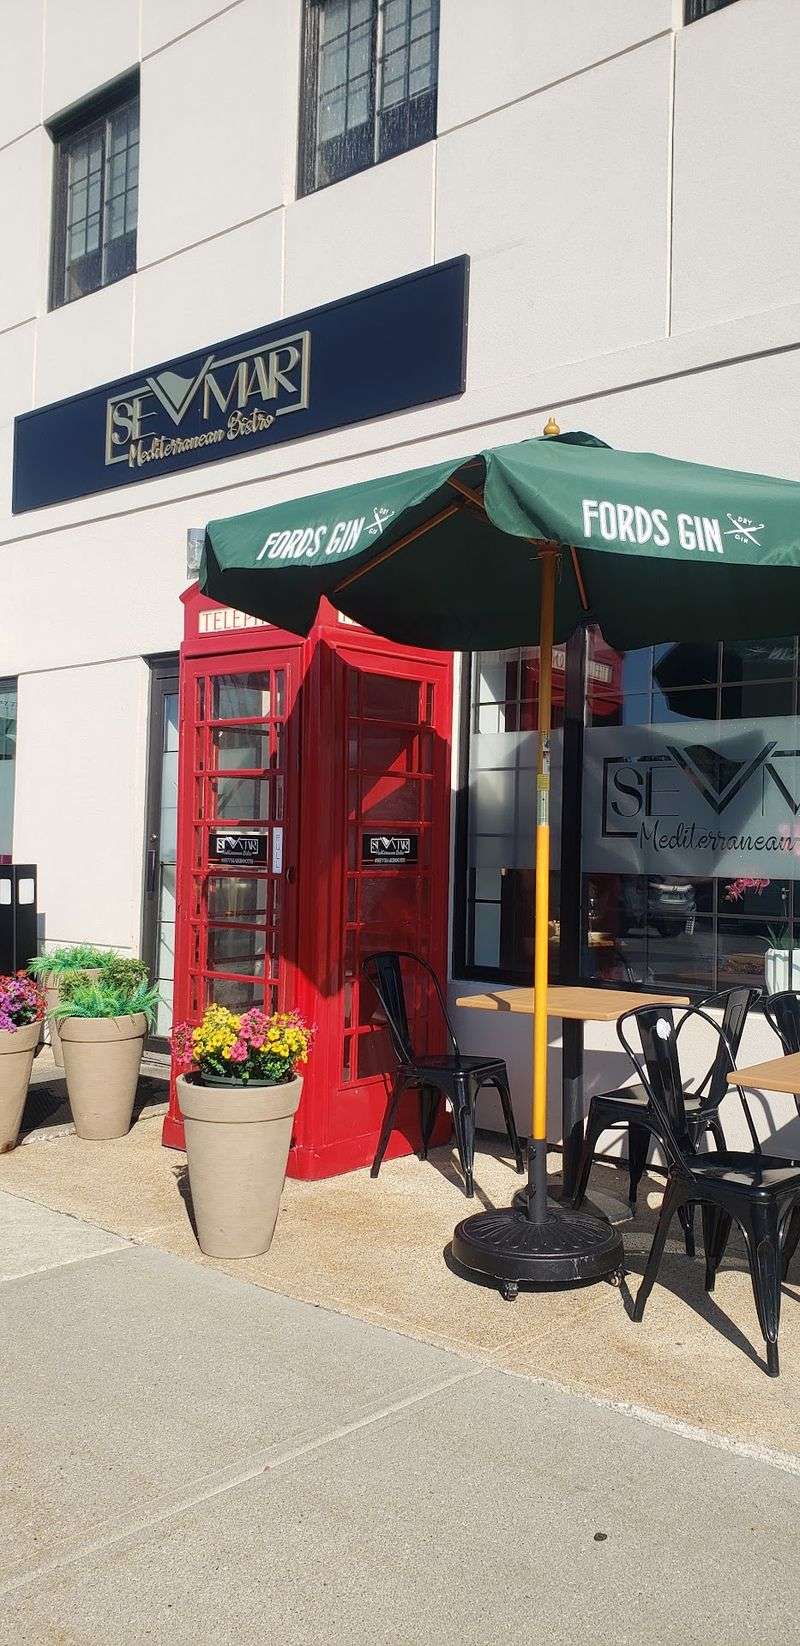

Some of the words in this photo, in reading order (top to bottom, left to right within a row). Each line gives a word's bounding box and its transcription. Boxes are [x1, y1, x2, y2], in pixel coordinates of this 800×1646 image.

[111, 346, 299, 445] SEVMAR
[127, 428, 226, 468] Mediterranean
[226, 407, 274, 441] Bistro
[256, 524, 327, 561] FORDS
[325, 516, 366, 556] GIN
[581, 499, 671, 547] FORDS
[676, 512, 725, 554] GIN
[737, 516, 752, 526] DRY
[203, 610, 265, 631] TELEP
[639, 819, 797, 852] Mediterranean
